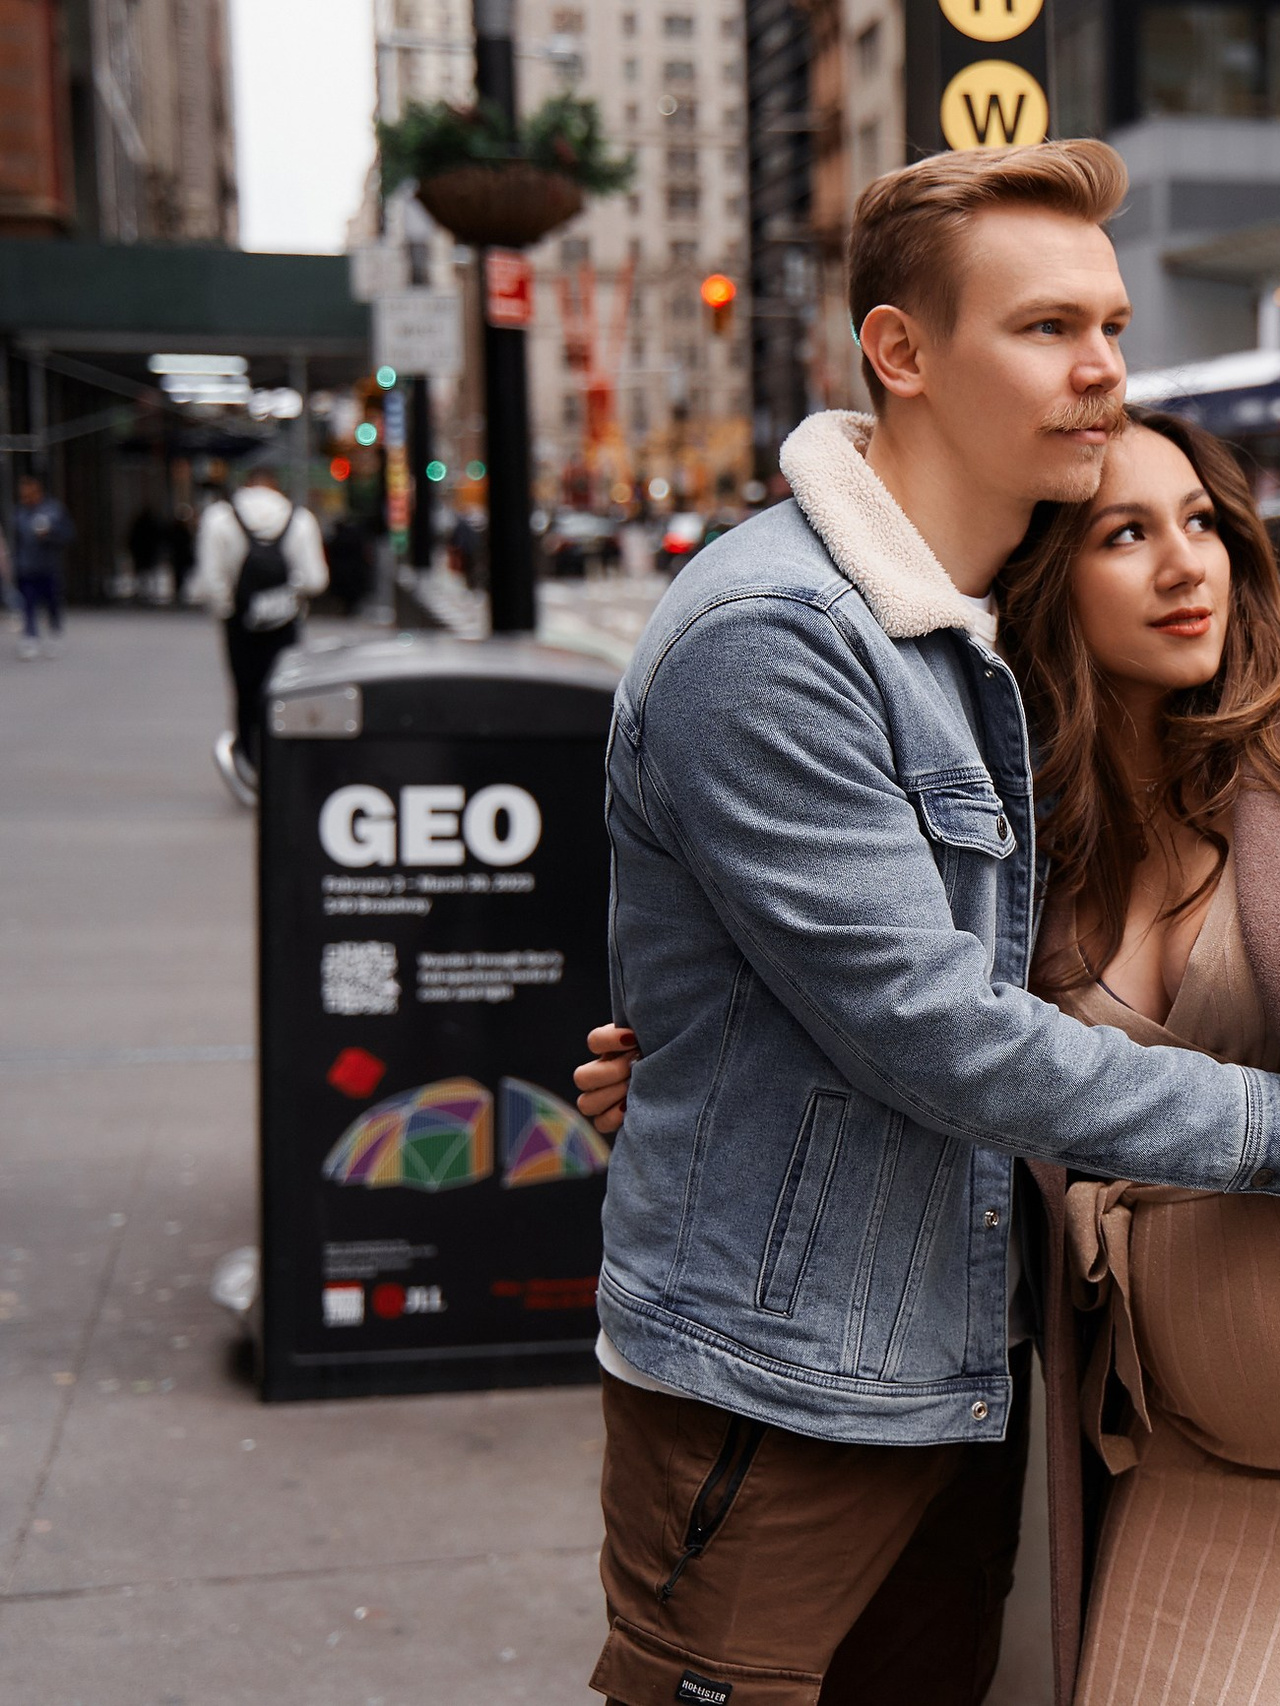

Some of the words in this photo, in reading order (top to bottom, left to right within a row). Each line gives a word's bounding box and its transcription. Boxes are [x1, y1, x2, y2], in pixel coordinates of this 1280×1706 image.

[962, 94, 1026, 144] W
[319, 784, 541, 867] GEO
[357, 896, 432, 917] Broadway
[682, 1680, 726, 1702] HOLLISTER
